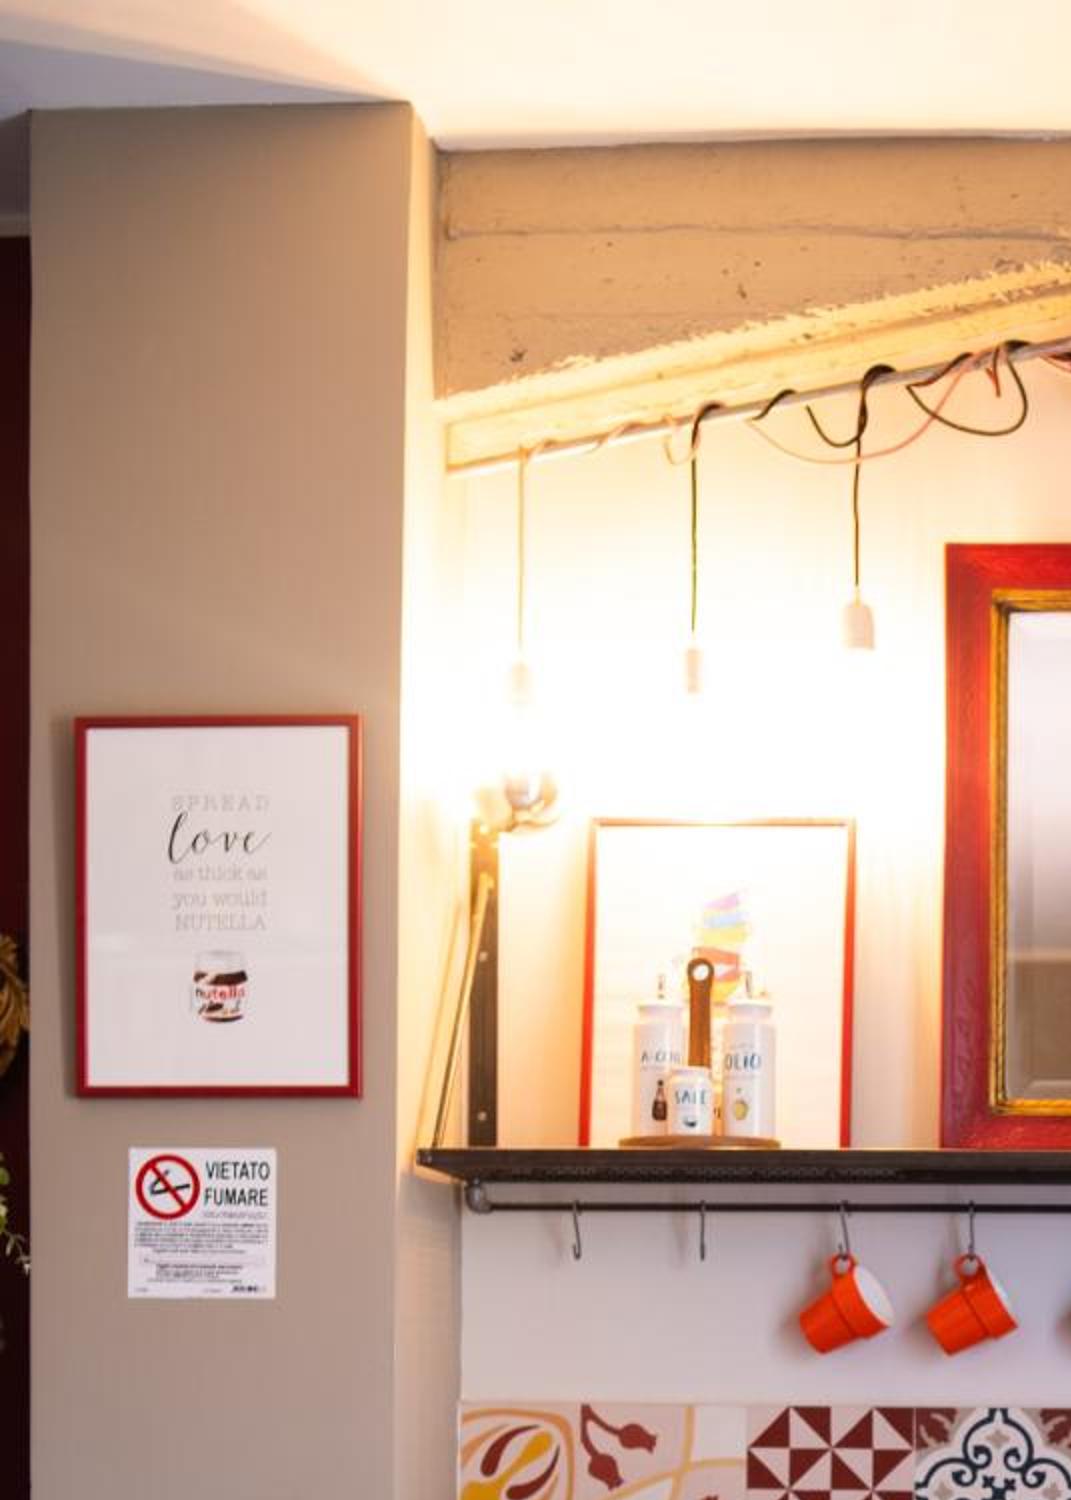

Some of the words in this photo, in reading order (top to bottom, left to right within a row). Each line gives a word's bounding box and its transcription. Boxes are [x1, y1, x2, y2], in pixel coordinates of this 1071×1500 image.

[168, 810, 271, 864] love
[205, 1161, 270, 1180] VIETATO
[204, 1187, 268, 1206] FUMARE
